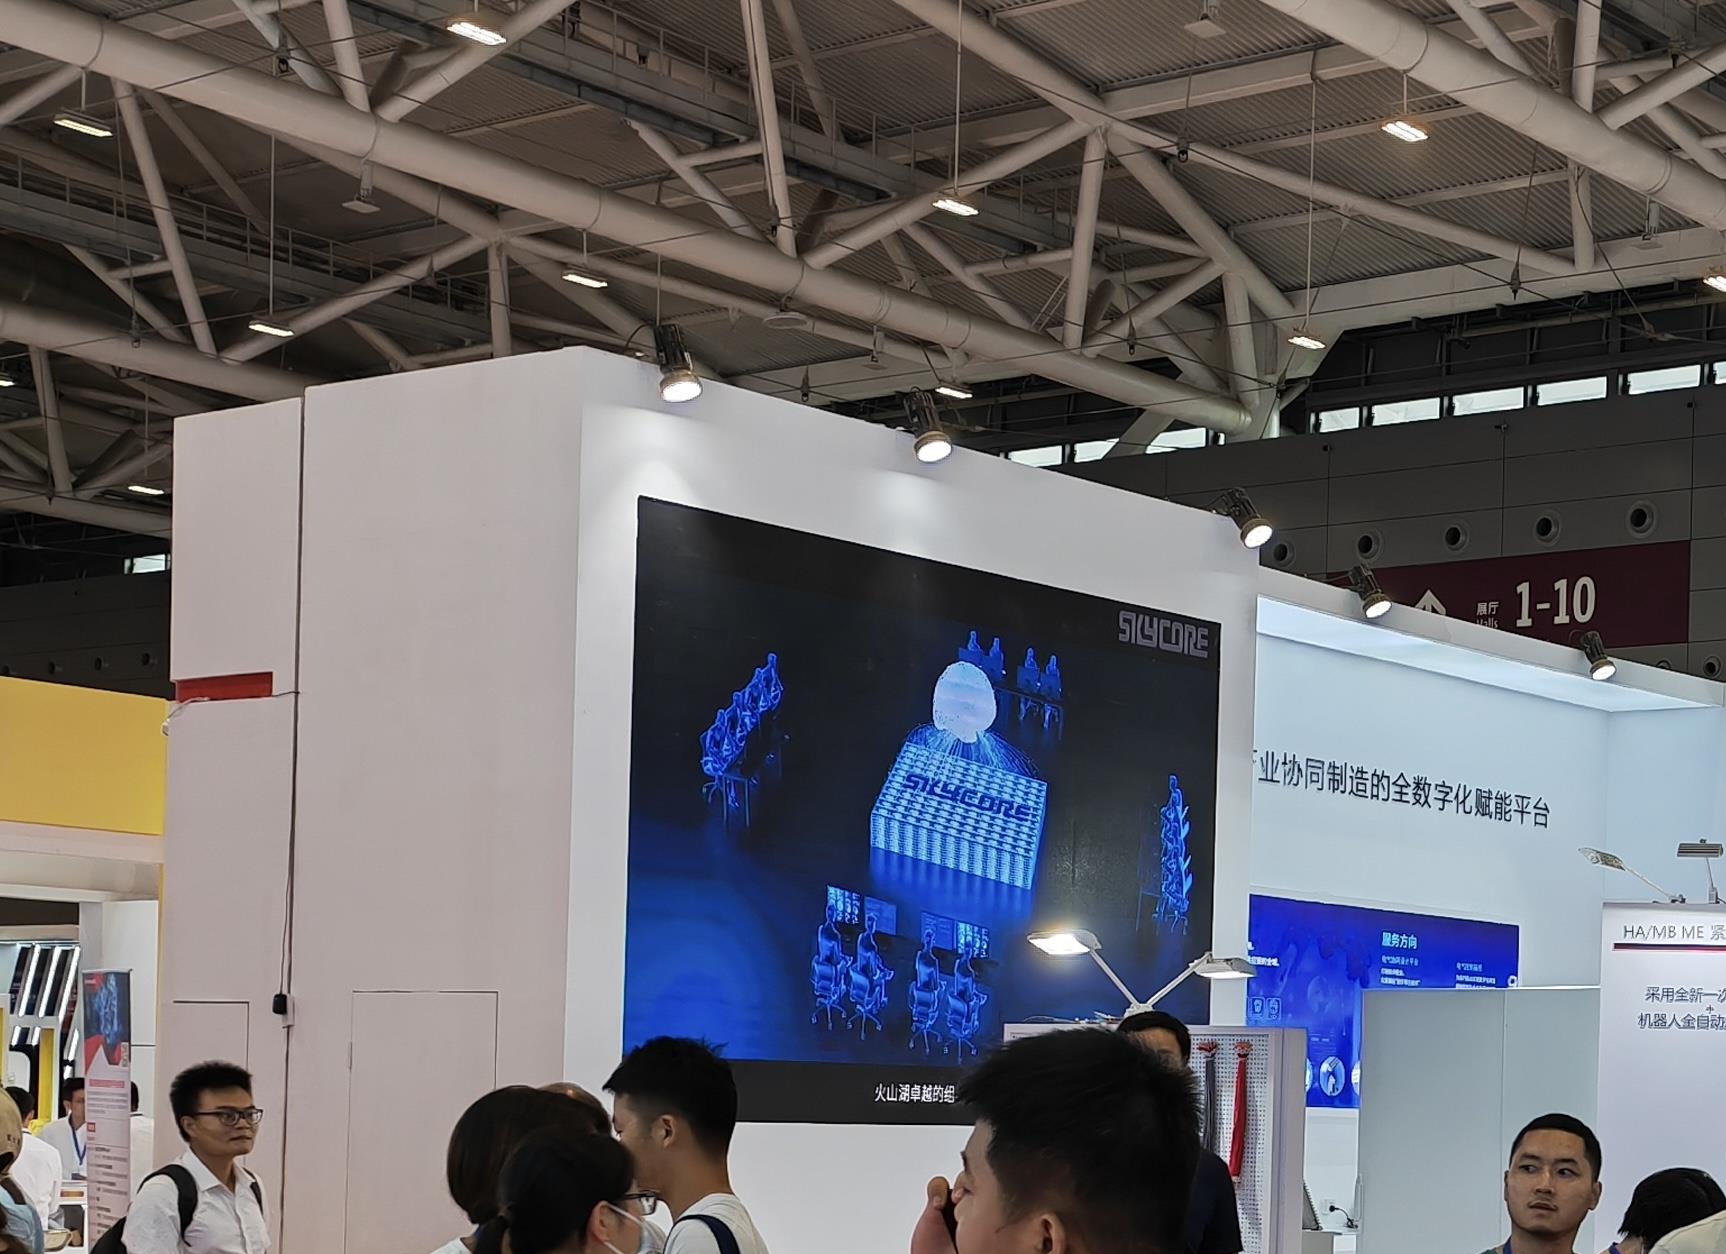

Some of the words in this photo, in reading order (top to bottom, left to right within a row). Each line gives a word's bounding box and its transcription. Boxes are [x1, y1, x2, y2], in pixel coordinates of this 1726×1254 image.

[1476, 601, 1499, 616] 展厅
[1515, 576, 1597, 628] 1-10
[1117, 609, 1209, 659] SKYCORE
[902, 772, 1037, 823] SKYCORE
[1253, 748, 1551, 829] 业协同制造的全数字化赋能平台
[1381, 931, 1418, 950] 服务方向
[1623, 925, 1677, 941] HA/MB
[1682, 925, 1705, 940] ME
[874, 1082, 956, 1103] 火山湖卓越的组
